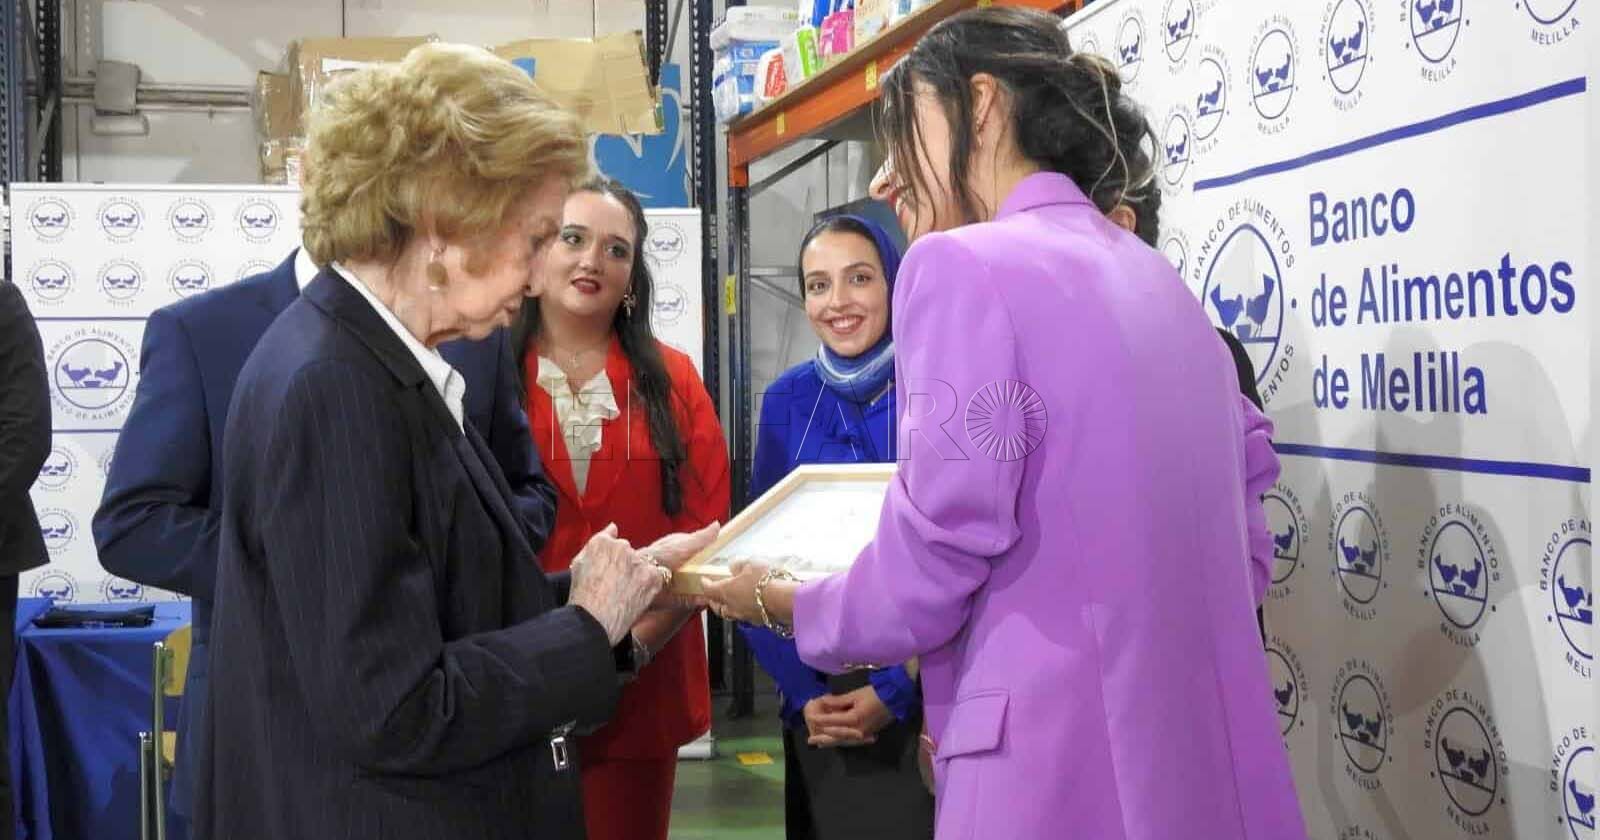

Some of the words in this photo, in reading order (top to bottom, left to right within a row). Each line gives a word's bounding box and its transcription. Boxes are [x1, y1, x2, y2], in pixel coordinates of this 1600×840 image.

[1531, 17, 1580, 45] MELILLA
[1421, 57, 1456, 82] MELILLA
[1193, 219, 1225, 280] BANCO
[1228, 201, 1241, 221] DE
[1243, 197, 1295, 268] ALIMENTOS
[1309, 188, 1415, 247] Banco
[1311, 273, 1348, 328] de
[1356, 252, 1576, 325] Alimentos
[1262, 345, 1294, 405] ENTOS
[1312, 354, 1350, 410] de
[1361, 352, 1487, 415] Melilla
[1417, 516, 1437, 569] BANCO
[1440, 504, 1452, 518] DE
[1456, 504, 1500, 581] ALIMENTOS
[1540, 531, 1560, 591] BANCO
[1562, 518, 1576, 533] DE
[1440, 622, 1480, 647] MELILLA
[1565, 651, 1592, 678] MELI
[1424, 699, 1444, 749] BANCO
[1446, 688, 1458, 701] DE
[1463, 690, 1510, 776] ALIMENTOS
[1550, 737, 1571, 792] BANCO
[1573, 726, 1588, 739] DE
